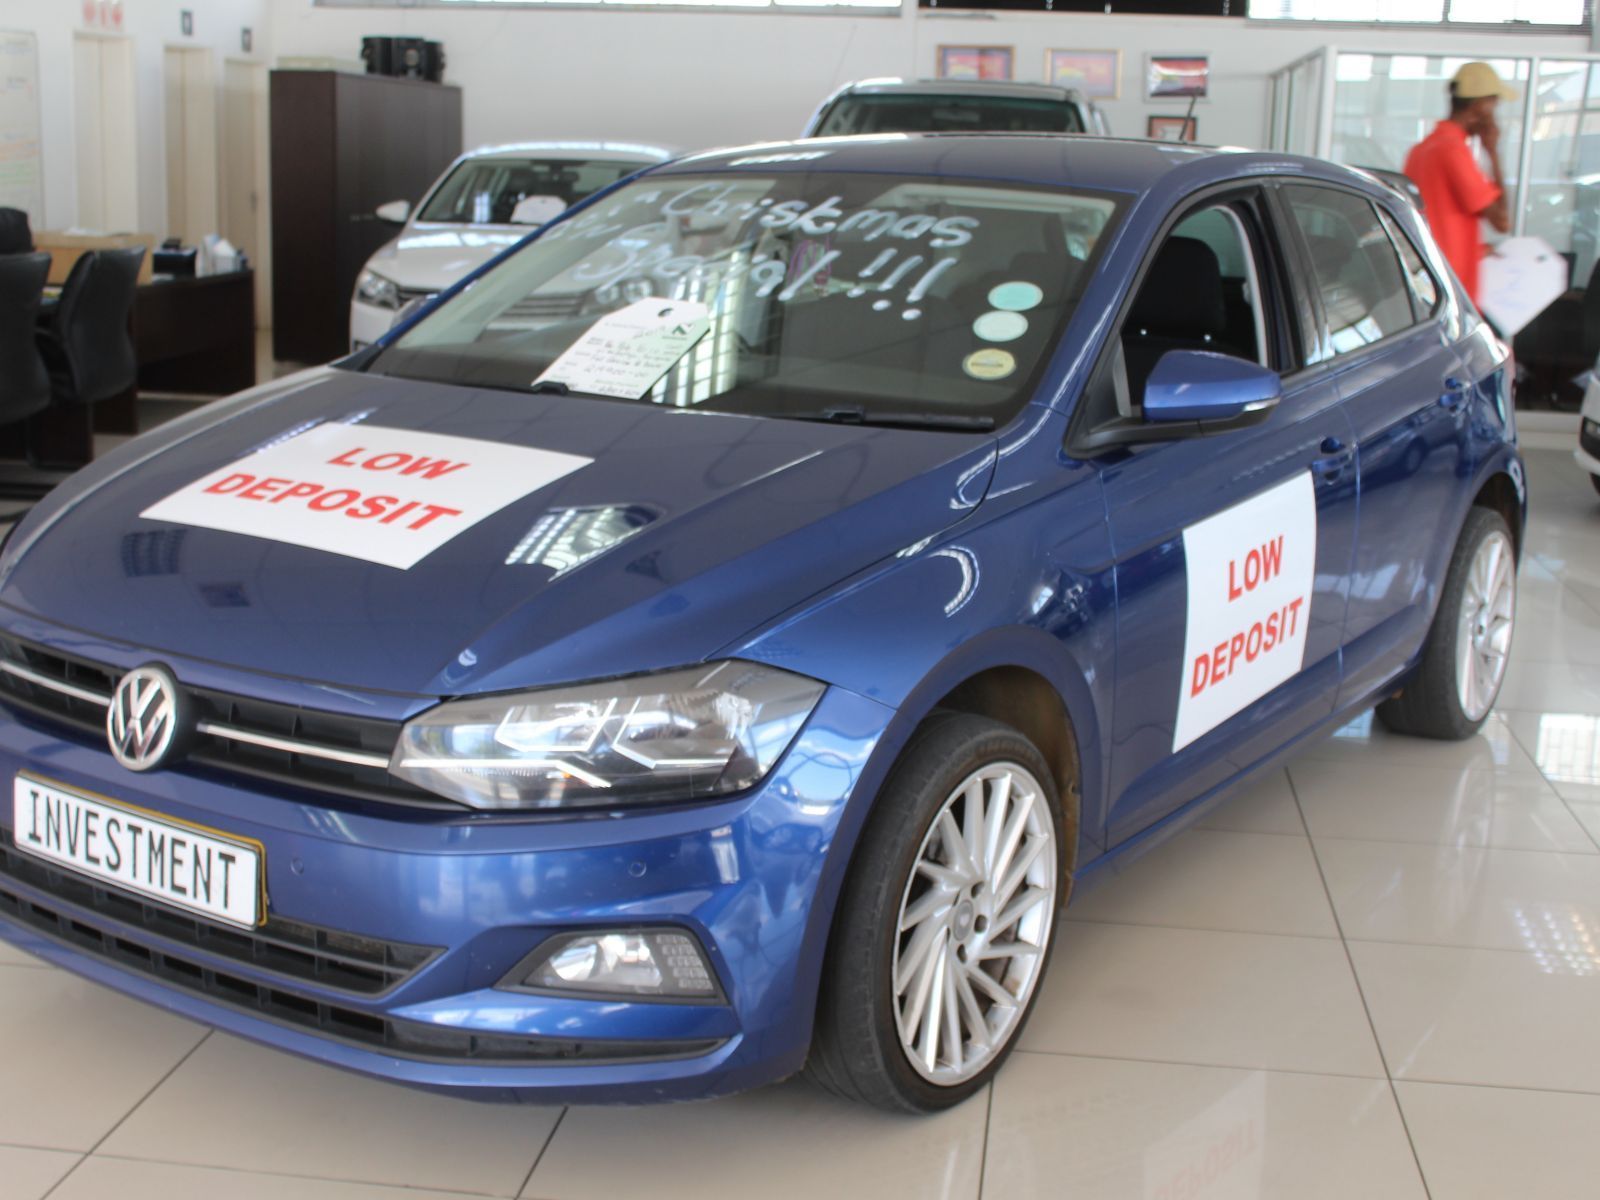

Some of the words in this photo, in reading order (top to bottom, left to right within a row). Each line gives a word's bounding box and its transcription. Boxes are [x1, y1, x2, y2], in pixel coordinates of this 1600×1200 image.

[326, 447, 469, 480] LOW
[203, 473, 463, 531] DEPOSIT
[1227, 535, 1284, 602] LOW
[1190, 596, 1304, 698] DEPOSIT
[28, 790, 236, 909] INVESTMENT
